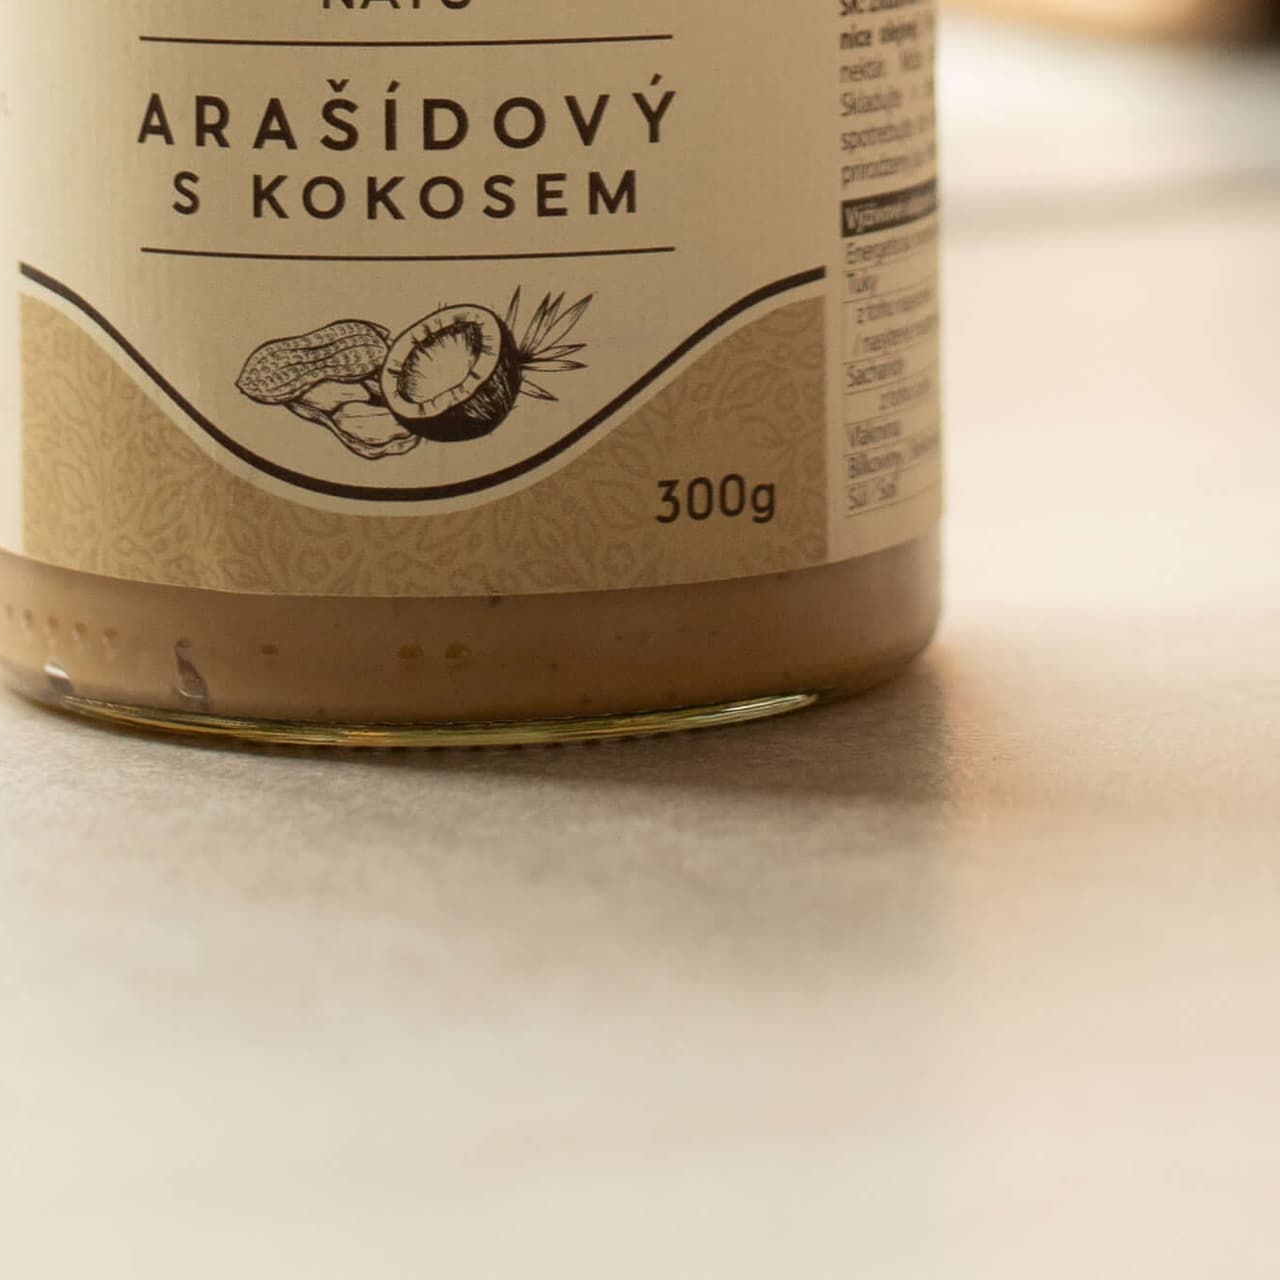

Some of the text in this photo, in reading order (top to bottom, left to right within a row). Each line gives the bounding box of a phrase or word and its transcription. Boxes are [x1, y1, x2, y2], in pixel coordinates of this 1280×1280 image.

[137, 73, 676, 151] ARAŠÍDOVÝ
[172, 170, 637, 220] S KOKOSEM
[655, 473, 775, 524] 300g
